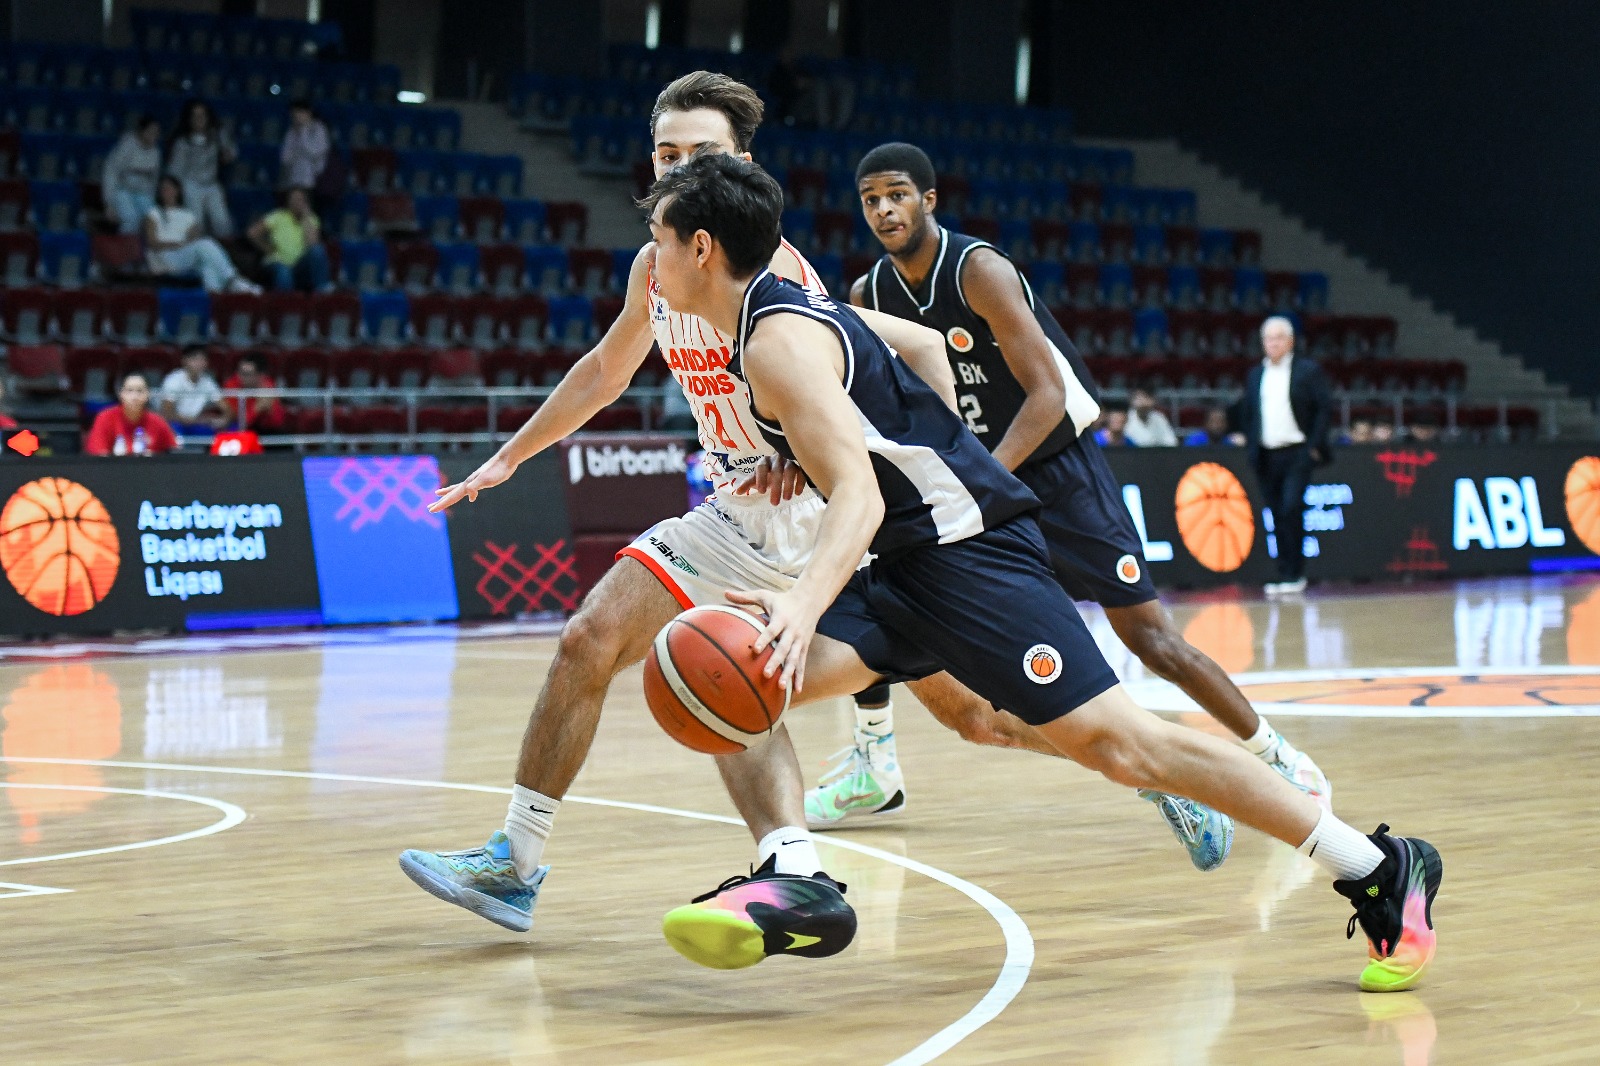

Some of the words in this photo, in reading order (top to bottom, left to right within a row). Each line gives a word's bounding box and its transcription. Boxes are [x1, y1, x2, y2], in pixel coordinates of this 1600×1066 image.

[957, 362, 989, 385] BK
[703, 403, 738, 449] 2
[586, 443, 687, 477] birbank
[733, 455, 765, 467] LANDA
[1453, 476, 1566, 550] ABL
[140, 529, 267, 564] Basketbol
